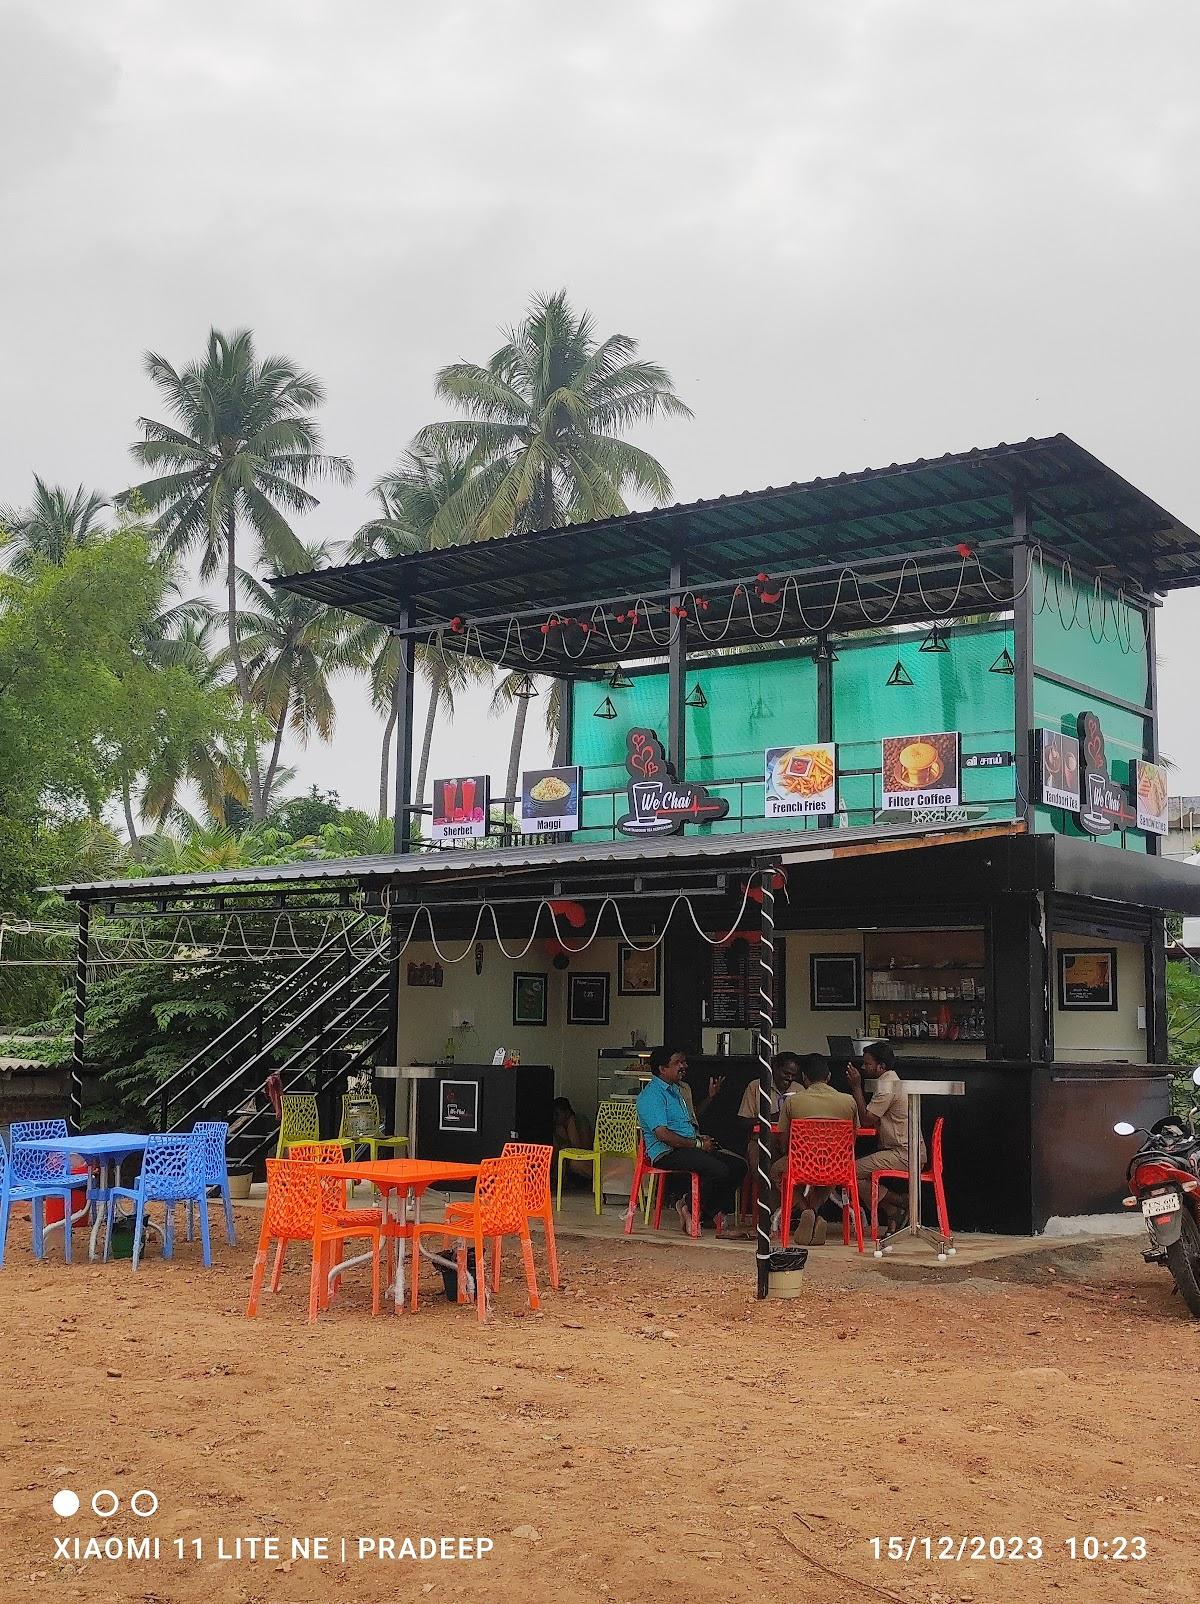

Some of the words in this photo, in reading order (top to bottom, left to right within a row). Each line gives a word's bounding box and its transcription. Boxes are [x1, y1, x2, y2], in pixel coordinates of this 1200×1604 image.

[641, 793, 660, 811] We
[662, 790, 692, 809] Chai
[773, 801, 802, 813] French
[804, 799, 826, 811] Fries
[888, 795, 914, 808] Filter
[917, 794, 951, 806] Coffee
[443, 825, 473, 836] Sherbet
[537, 818, 561, 831] Maggi
